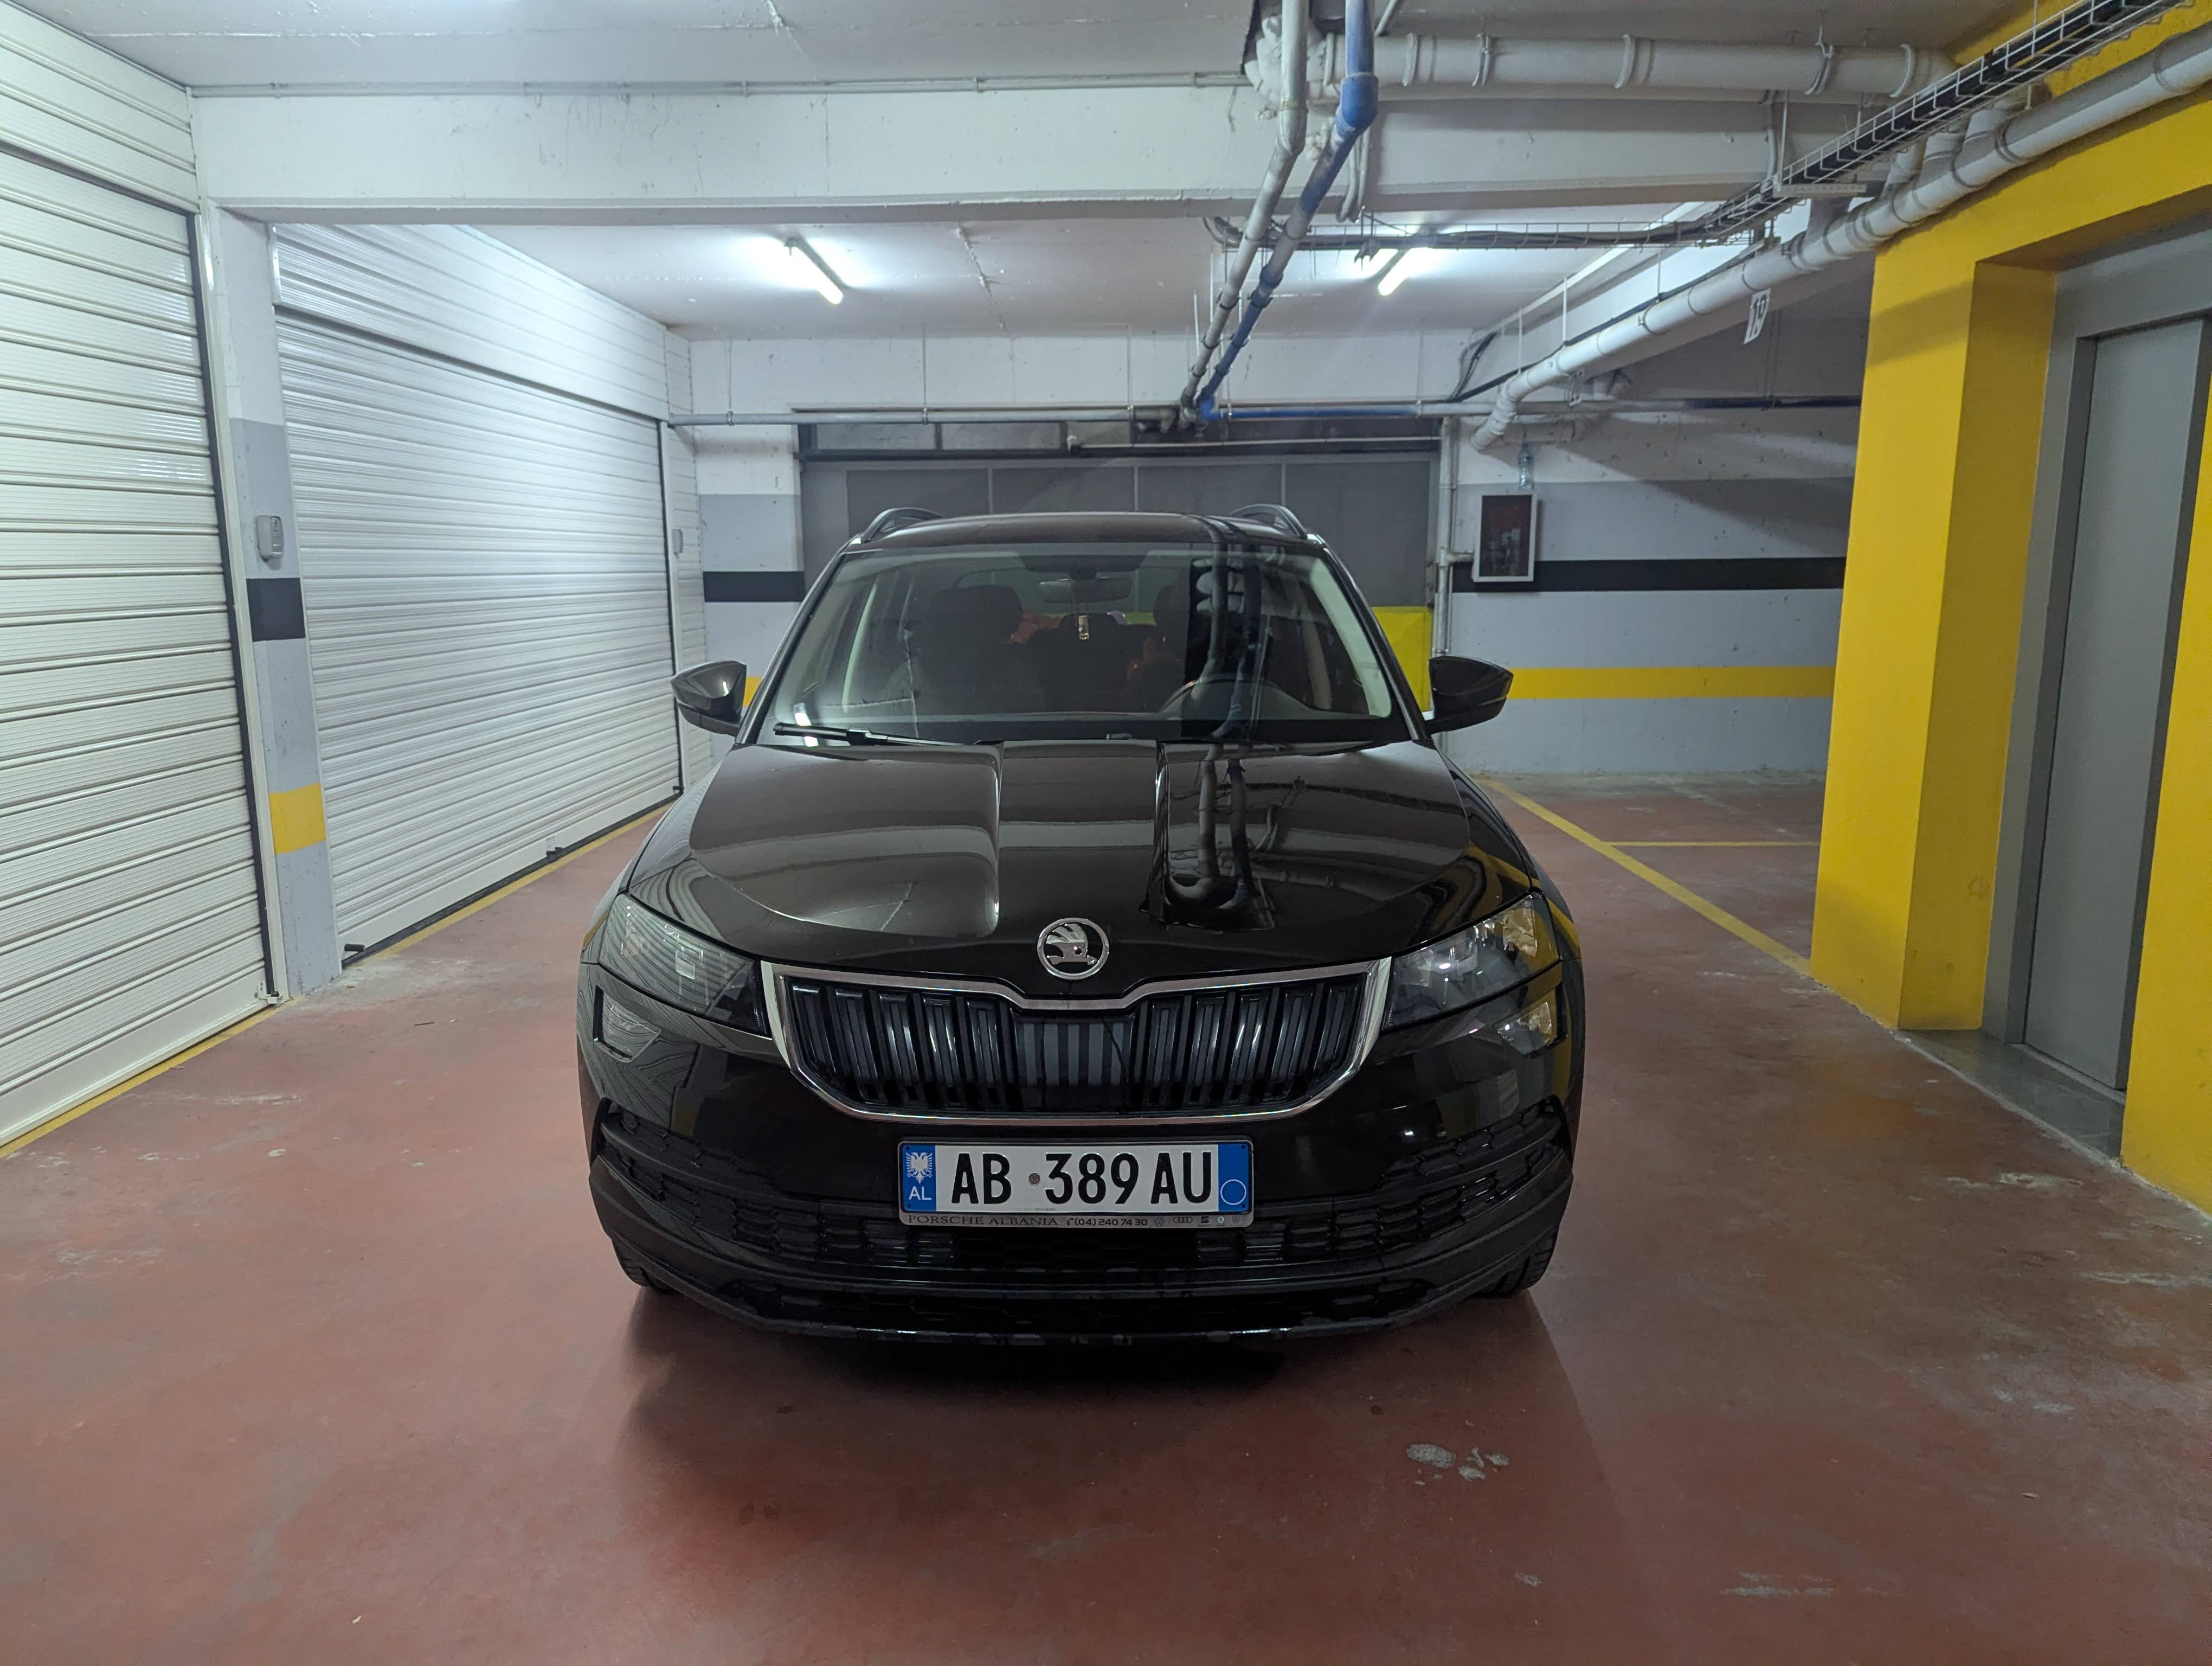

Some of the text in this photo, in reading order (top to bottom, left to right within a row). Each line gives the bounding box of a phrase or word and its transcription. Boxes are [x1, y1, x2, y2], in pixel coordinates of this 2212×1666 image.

[951, 1152, 1211, 1204] AB 389 AU
[908, 1186, 933, 1201] AL
[908, 1216, 985, 1225] PORSCHE
[988, 1216, 1058, 1226] ALBANIA
[1074, 1217, 1096, 1226] (04)
